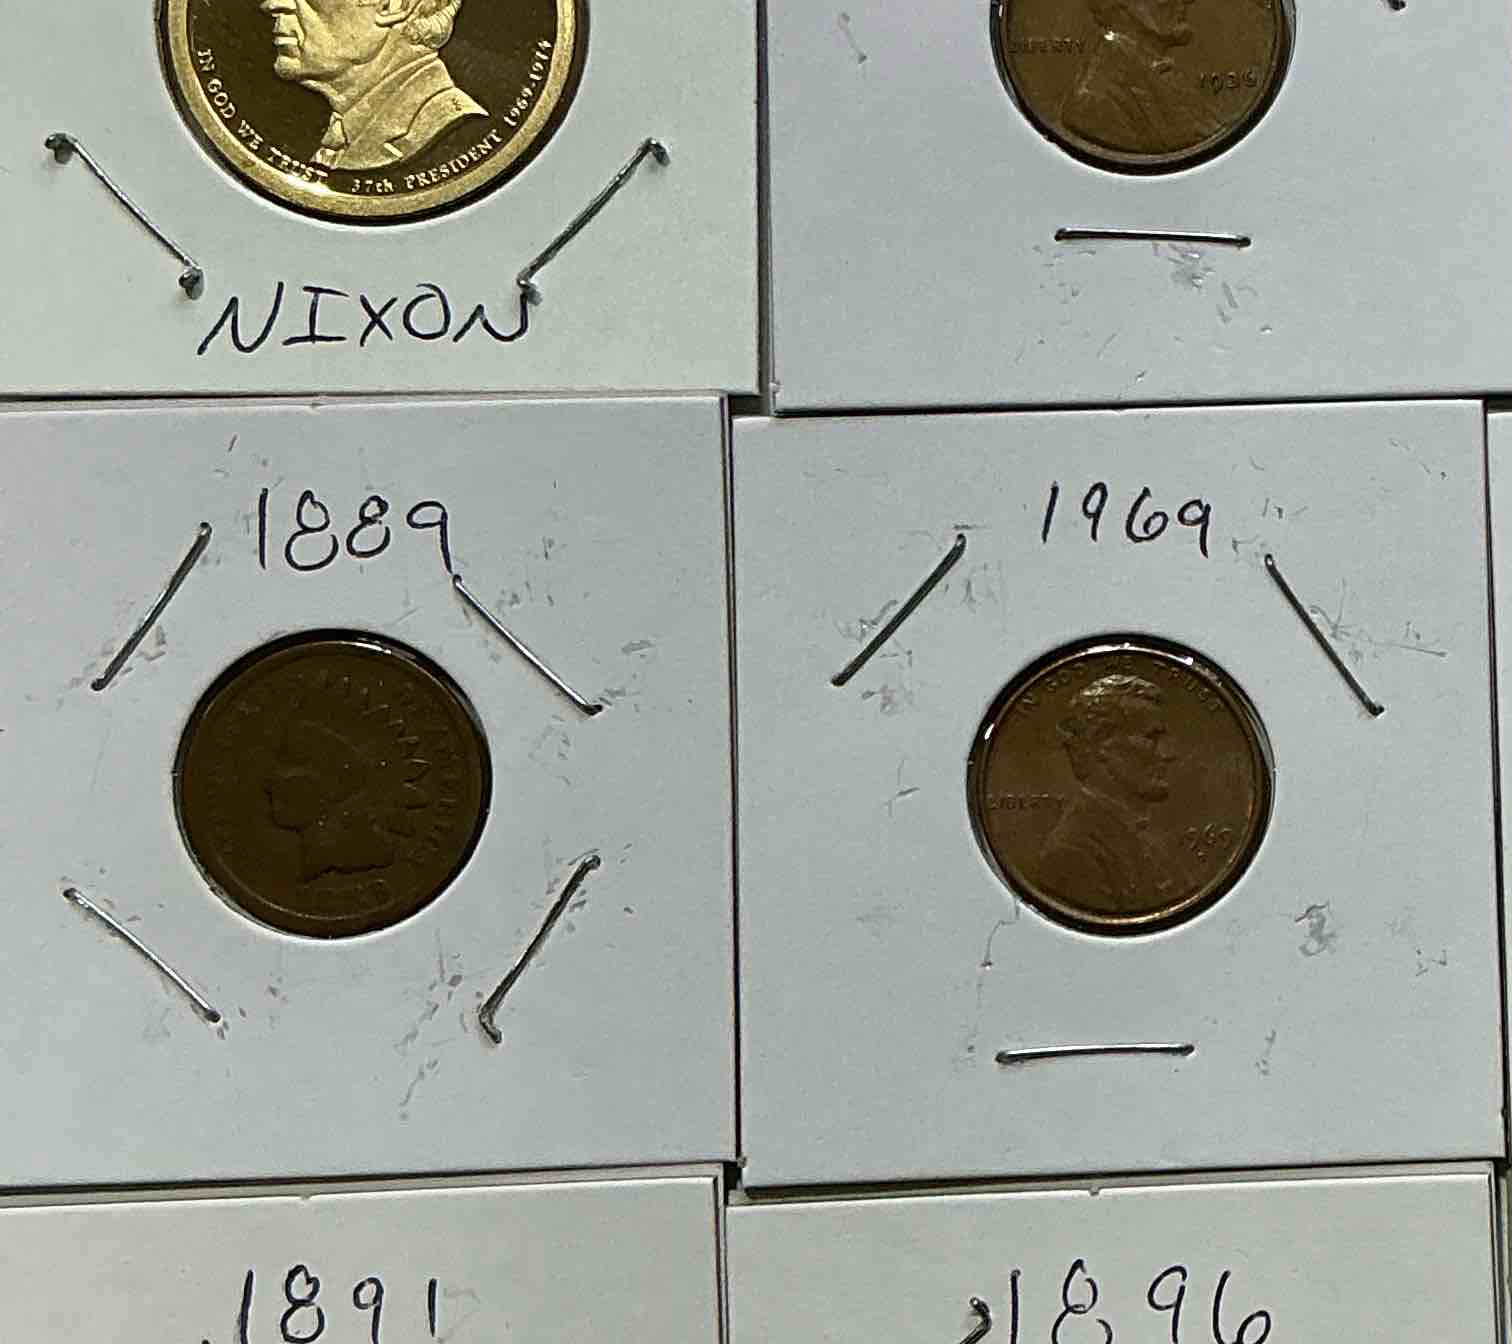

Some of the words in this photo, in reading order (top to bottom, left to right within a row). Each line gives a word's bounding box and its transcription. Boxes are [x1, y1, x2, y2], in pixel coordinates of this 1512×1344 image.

[197, 48, 216, 73] IN
[205, 80, 236, 120] GOD
[238, 119, 264, 152] WE
[405, 132, 504, 191] PRESIDENT
[196, 281, 533, 356] NIXON
[255, 486, 456, 575] 1889
[1040, 480, 1213, 558] 1969
